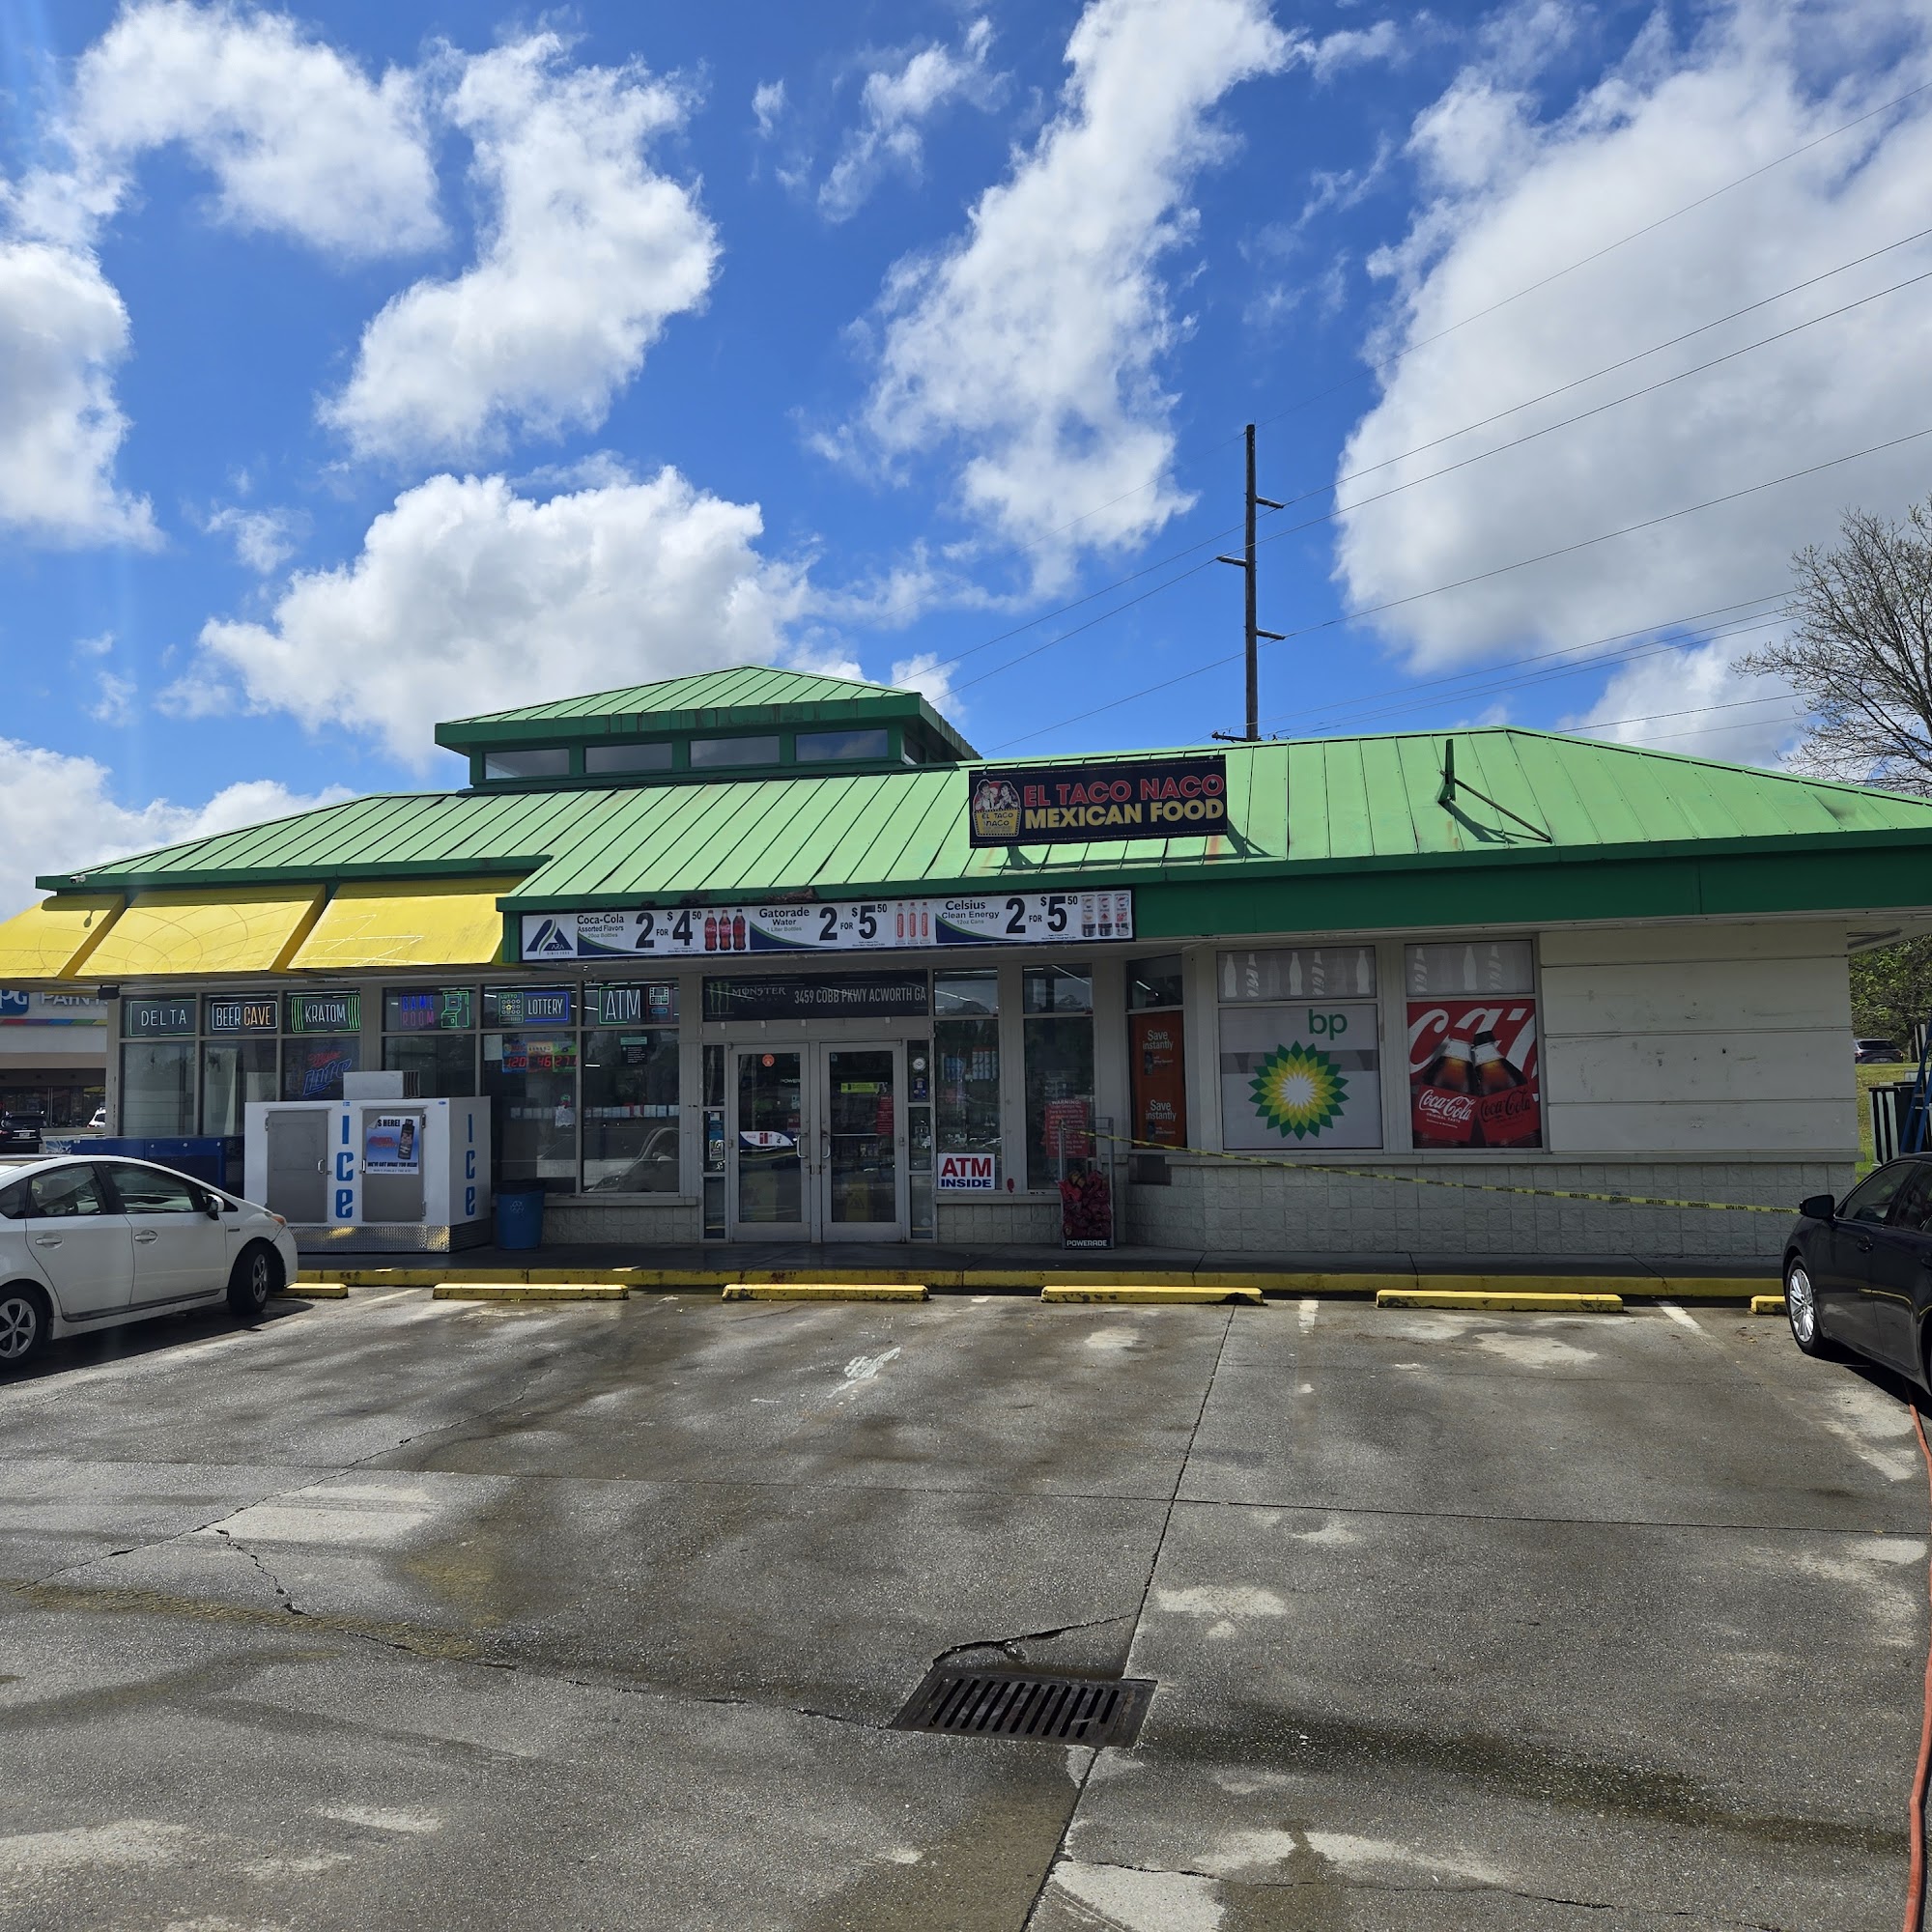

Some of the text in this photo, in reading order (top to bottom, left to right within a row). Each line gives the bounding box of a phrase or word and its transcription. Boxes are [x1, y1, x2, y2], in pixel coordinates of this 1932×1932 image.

[1023, 774, 1225, 808] EL TACO NACO
[1024, 798, 1225, 830] MEXICAN FOOD
[759, 906, 810, 919] Gatorade
[945, 899, 986, 911] Celsius
[577, 913, 625, 925] Coca-Cola
[772, 918, 797, 926] Water
[818, 906, 838, 941] 2
[839, 922, 854, 930] FOR
[969, 910, 1000, 920] Energy
[1006, 897, 1026, 934] 2
[1029, 914, 1042, 923] FOR
[635, 911, 655, 949] 2
[656, 928, 668, 937] FOR
[605, 988, 641, 1020] ATM
[794, 986, 926, 1005] 3459 COBB PKWY ACWORTH GA
[304, 1003, 347, 1023] KRATOM
[527, 998, 563, 1015] LOTTERY
[141, 1009, 187, 1027] DELTA
[215, 1006, 271, 1027] BEER CAVE
[1308, 1009, 1348, 1040] bp
[1147, 1029, 1169, 1041] Save
[1142, 1039, 1174, 1051] instantly
[1150, 1098, 1172, 1111] Save
[1418, 1089, 1477, 1121] Coca-Cola
[1145, 1110, 1178, 1122] instantly
[941, 1157, 991, 1178] ATM
[941, 1179, 992, 1188] INSIDE
[1065, 1238, 1108, 1248] POWERADE
